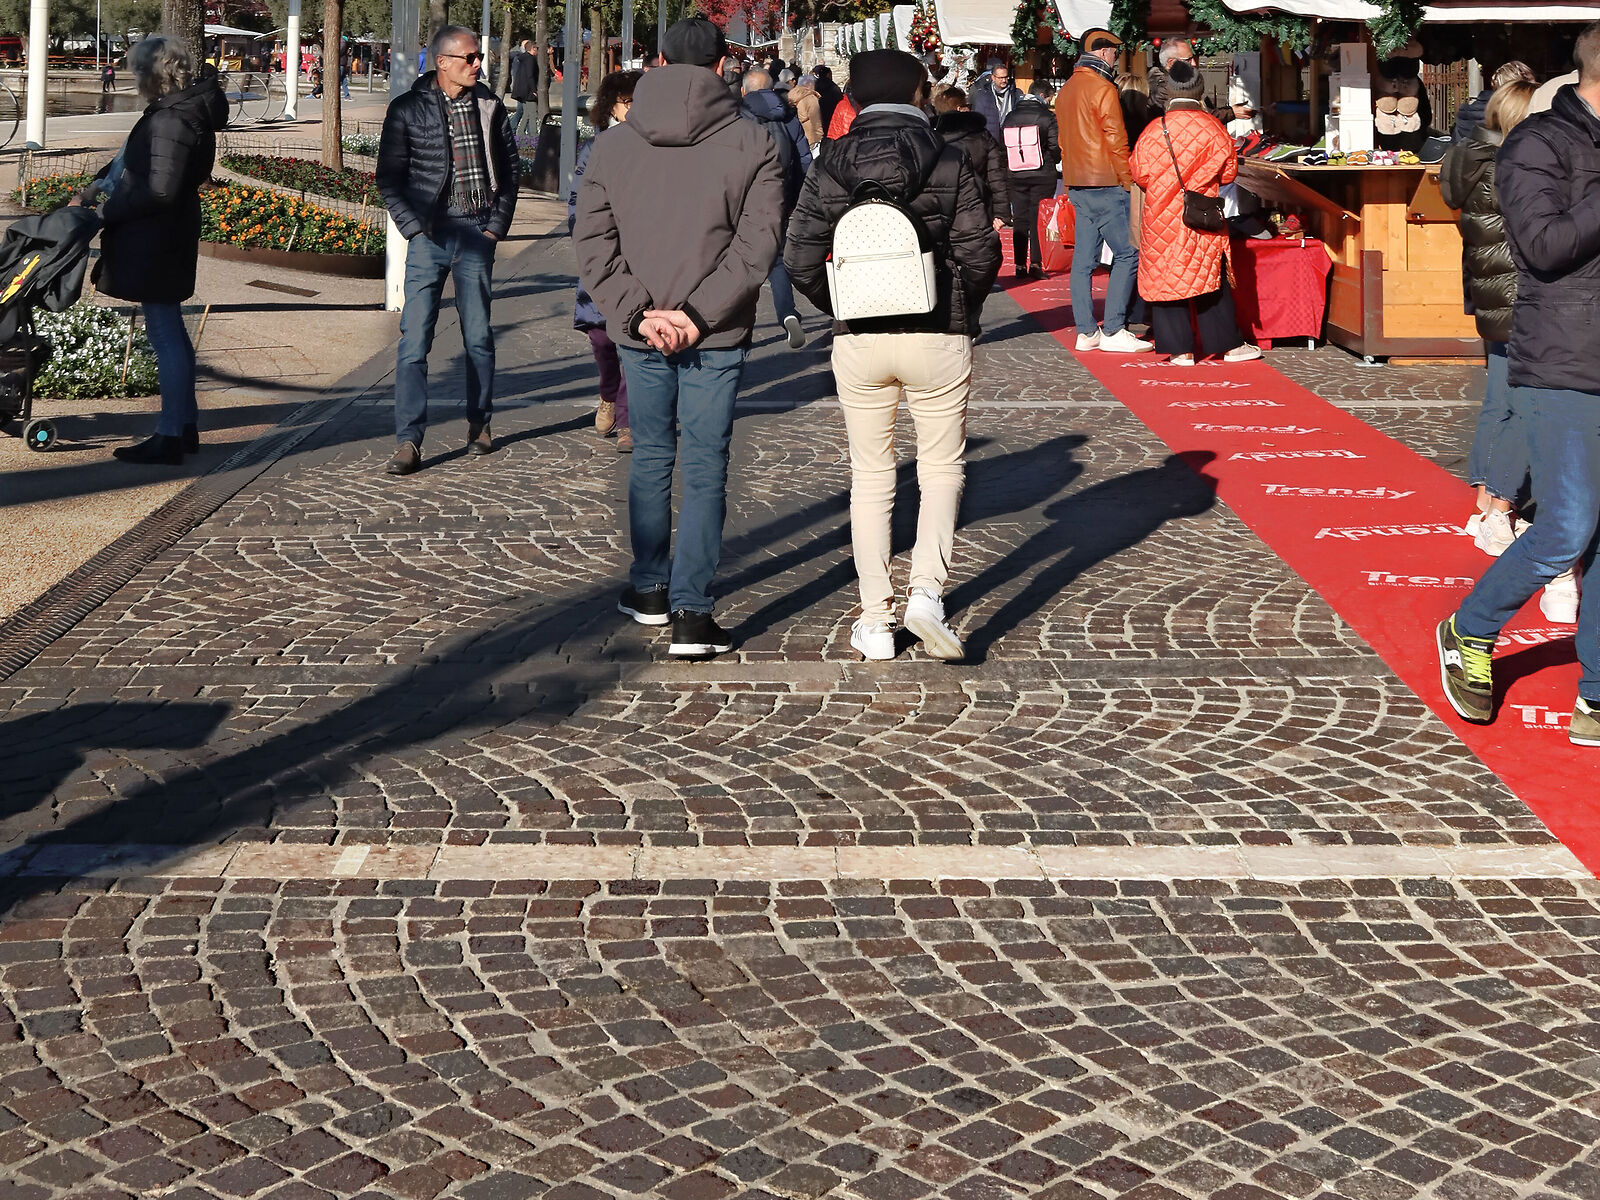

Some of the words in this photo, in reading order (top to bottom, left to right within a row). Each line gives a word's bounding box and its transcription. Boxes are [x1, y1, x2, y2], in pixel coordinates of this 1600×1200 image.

[1190, 423, 1322, 435] Trendy
[1227, 449, 1367, 462] Trendy
[1261, 483, 1416, 499] Trendy
[1360, 570, 1475, 586] Tren
